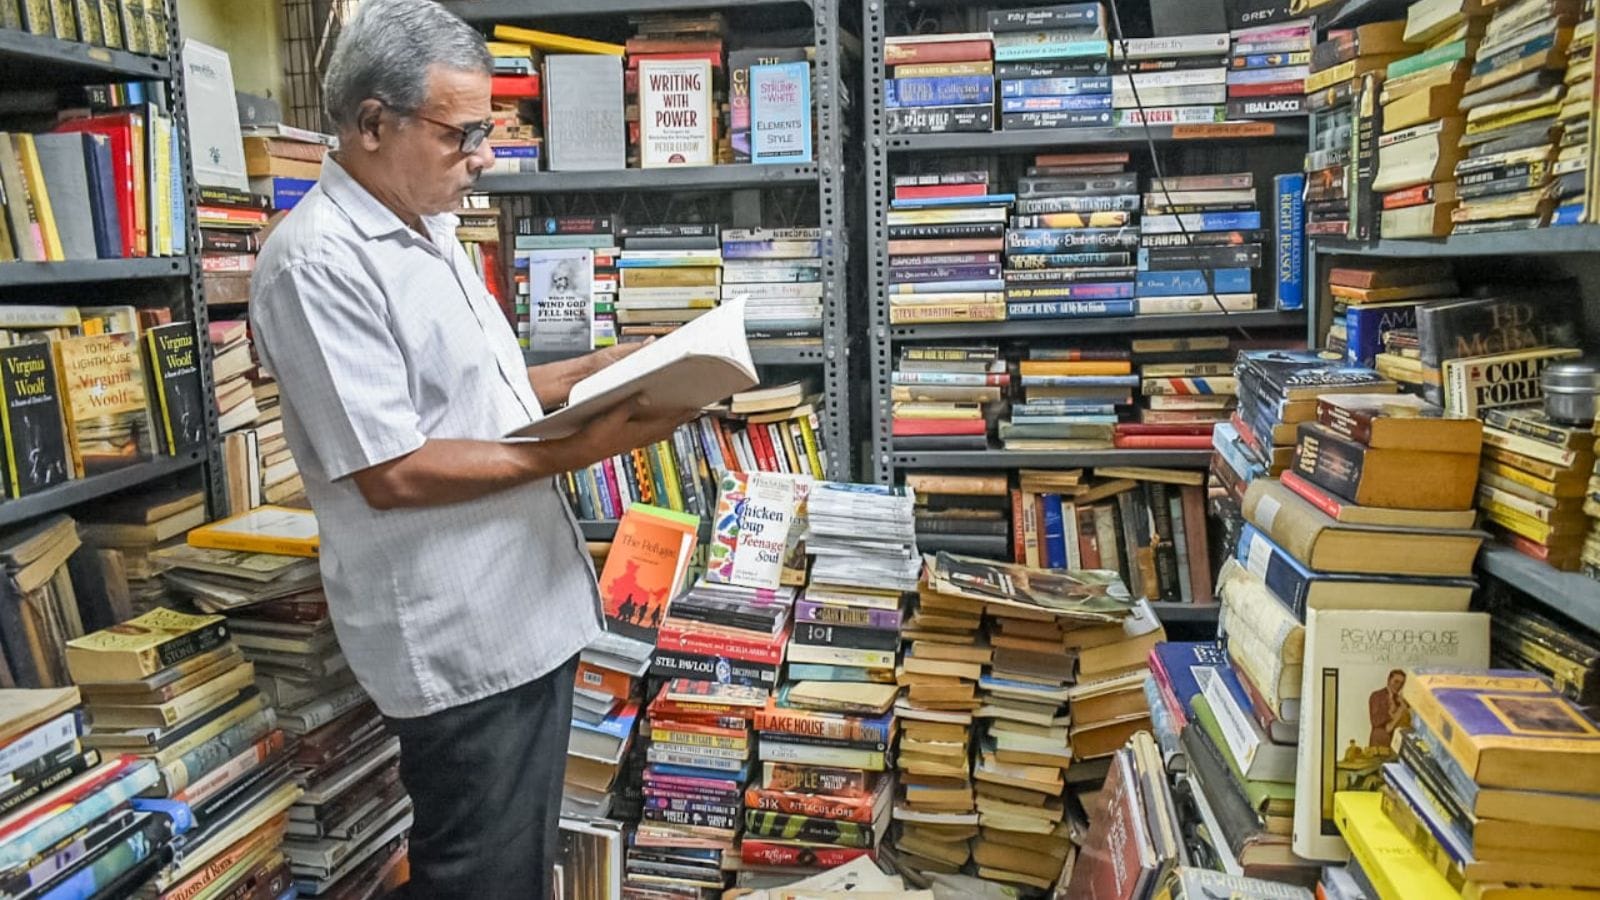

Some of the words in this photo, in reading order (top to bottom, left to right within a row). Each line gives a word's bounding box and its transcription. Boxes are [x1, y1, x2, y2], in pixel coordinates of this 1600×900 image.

[1241, 8, 1276, 22] GREY
[649, 73, 701, 92] WRITING
[663, 93, 689, 108] WITH
[1250, 100, 1300, 113] BALDACCI
[655, 110, 697, 128] POWER
[756, 120, 802, 131] ELEMENTS
[903, 113, 926, 127] SPACE
[927, 112, 950, 127] WOLF
[766, 133, 793, 144] STYLE
[1279, 193, 1292, 230] RIGHT
[1279, 232, 1292, 283] REASON
[1008, 289, 1032, 298] DAVID
[537, 301, 565, 309] WIND
[566, 300, 587, 309] GOD
[538, 309, 562, 318] FELL
[563, 308, 587, 317] SICK
[1009, 305, 1034, 315] GEORGE
[84, 343, 97, 354] TO
[158, 332, 193, 353] Virginia
[7, 354, 46, 378] Virginia
[72, 352, 132, 370] LIGHTHOUSE
[166, 350, 193, 369] Woolf
[15, 376, 45, 397] Woolf
[79, 369, 131, 391] Virginia
[88, 388, 128, 408] Woolf
[735, 498, 784, 523] Chicken
[622, 534, 641, 547] The
[740, 533, 786, 554] Teenage
[755, 549, 780, 565] Soul
[654, 656, 678, 669] STEL
[678, 658, 715, 674] PAVLOU
[762, 715, 793, 733] LAKE
[794, 719, 825, 737] HOUSE
[758, 797, 780, 810] SIX
